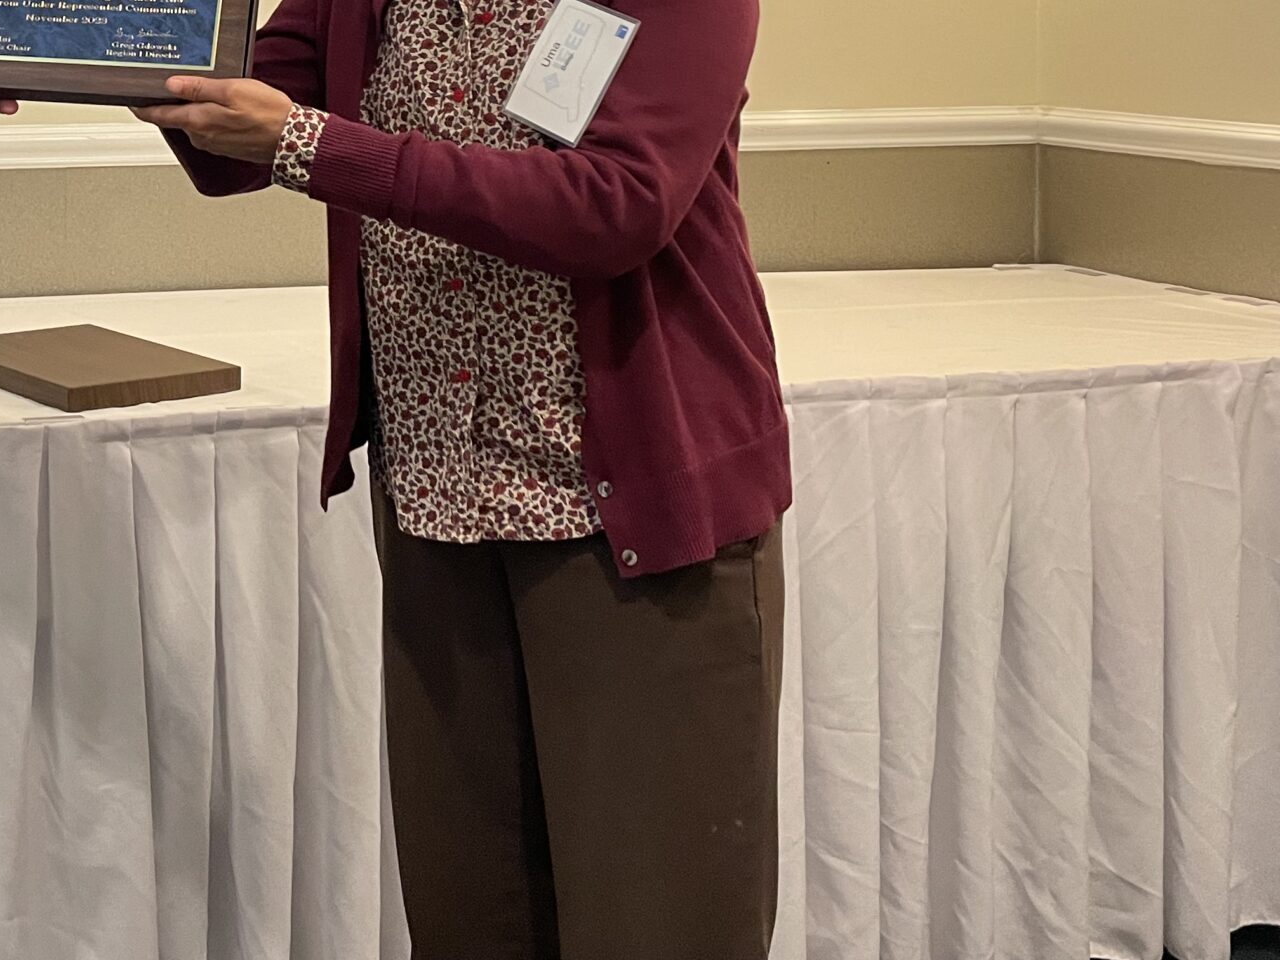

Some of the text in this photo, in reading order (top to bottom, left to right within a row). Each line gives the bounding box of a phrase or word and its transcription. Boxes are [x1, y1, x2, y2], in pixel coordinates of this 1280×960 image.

[22, 0, 54, 9] Under
[58, 2, 123, 12] Represented
[125, 4, 197, 15] Communities
[25, 14, 78, 24] November
[6, 43, 32, 52] Chair
[111, 41, 135, 50] Greg
[106, 49, 137, 58] Region
[145, 50, 181, 59] Director
[541, 42, 561, 68] Uma
